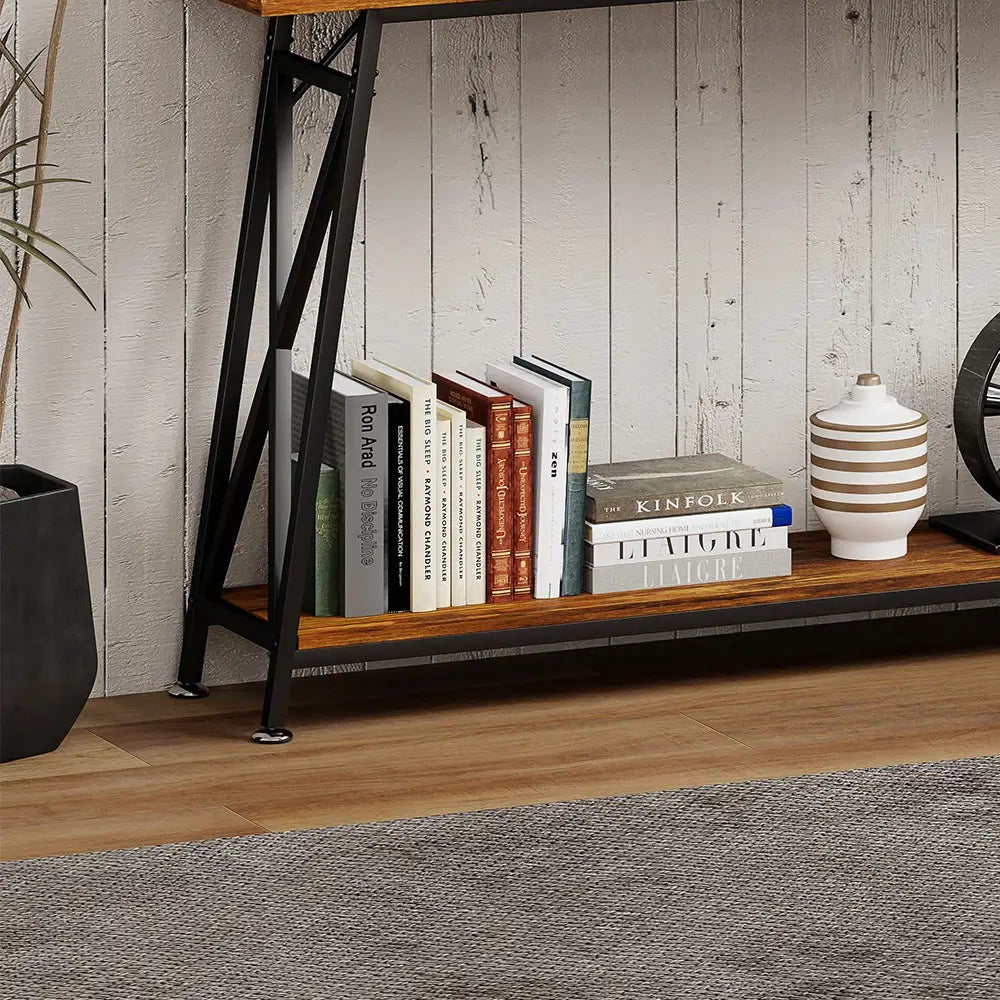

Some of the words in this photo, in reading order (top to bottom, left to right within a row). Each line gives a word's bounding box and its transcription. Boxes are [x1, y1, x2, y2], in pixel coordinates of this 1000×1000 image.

[361, 404, 377, 432] Ron
[361, 436, 377, 469] Arad
[397, 466, 404, 475] OF
[361, 477, 378, 498] No
[636, 491, 745, 513] KINFOLK
[357, 501, 378, 566] Discipline
[635, 526, 667, 537] NURSING
[643, 556, 743, 588] LIAIGRE
